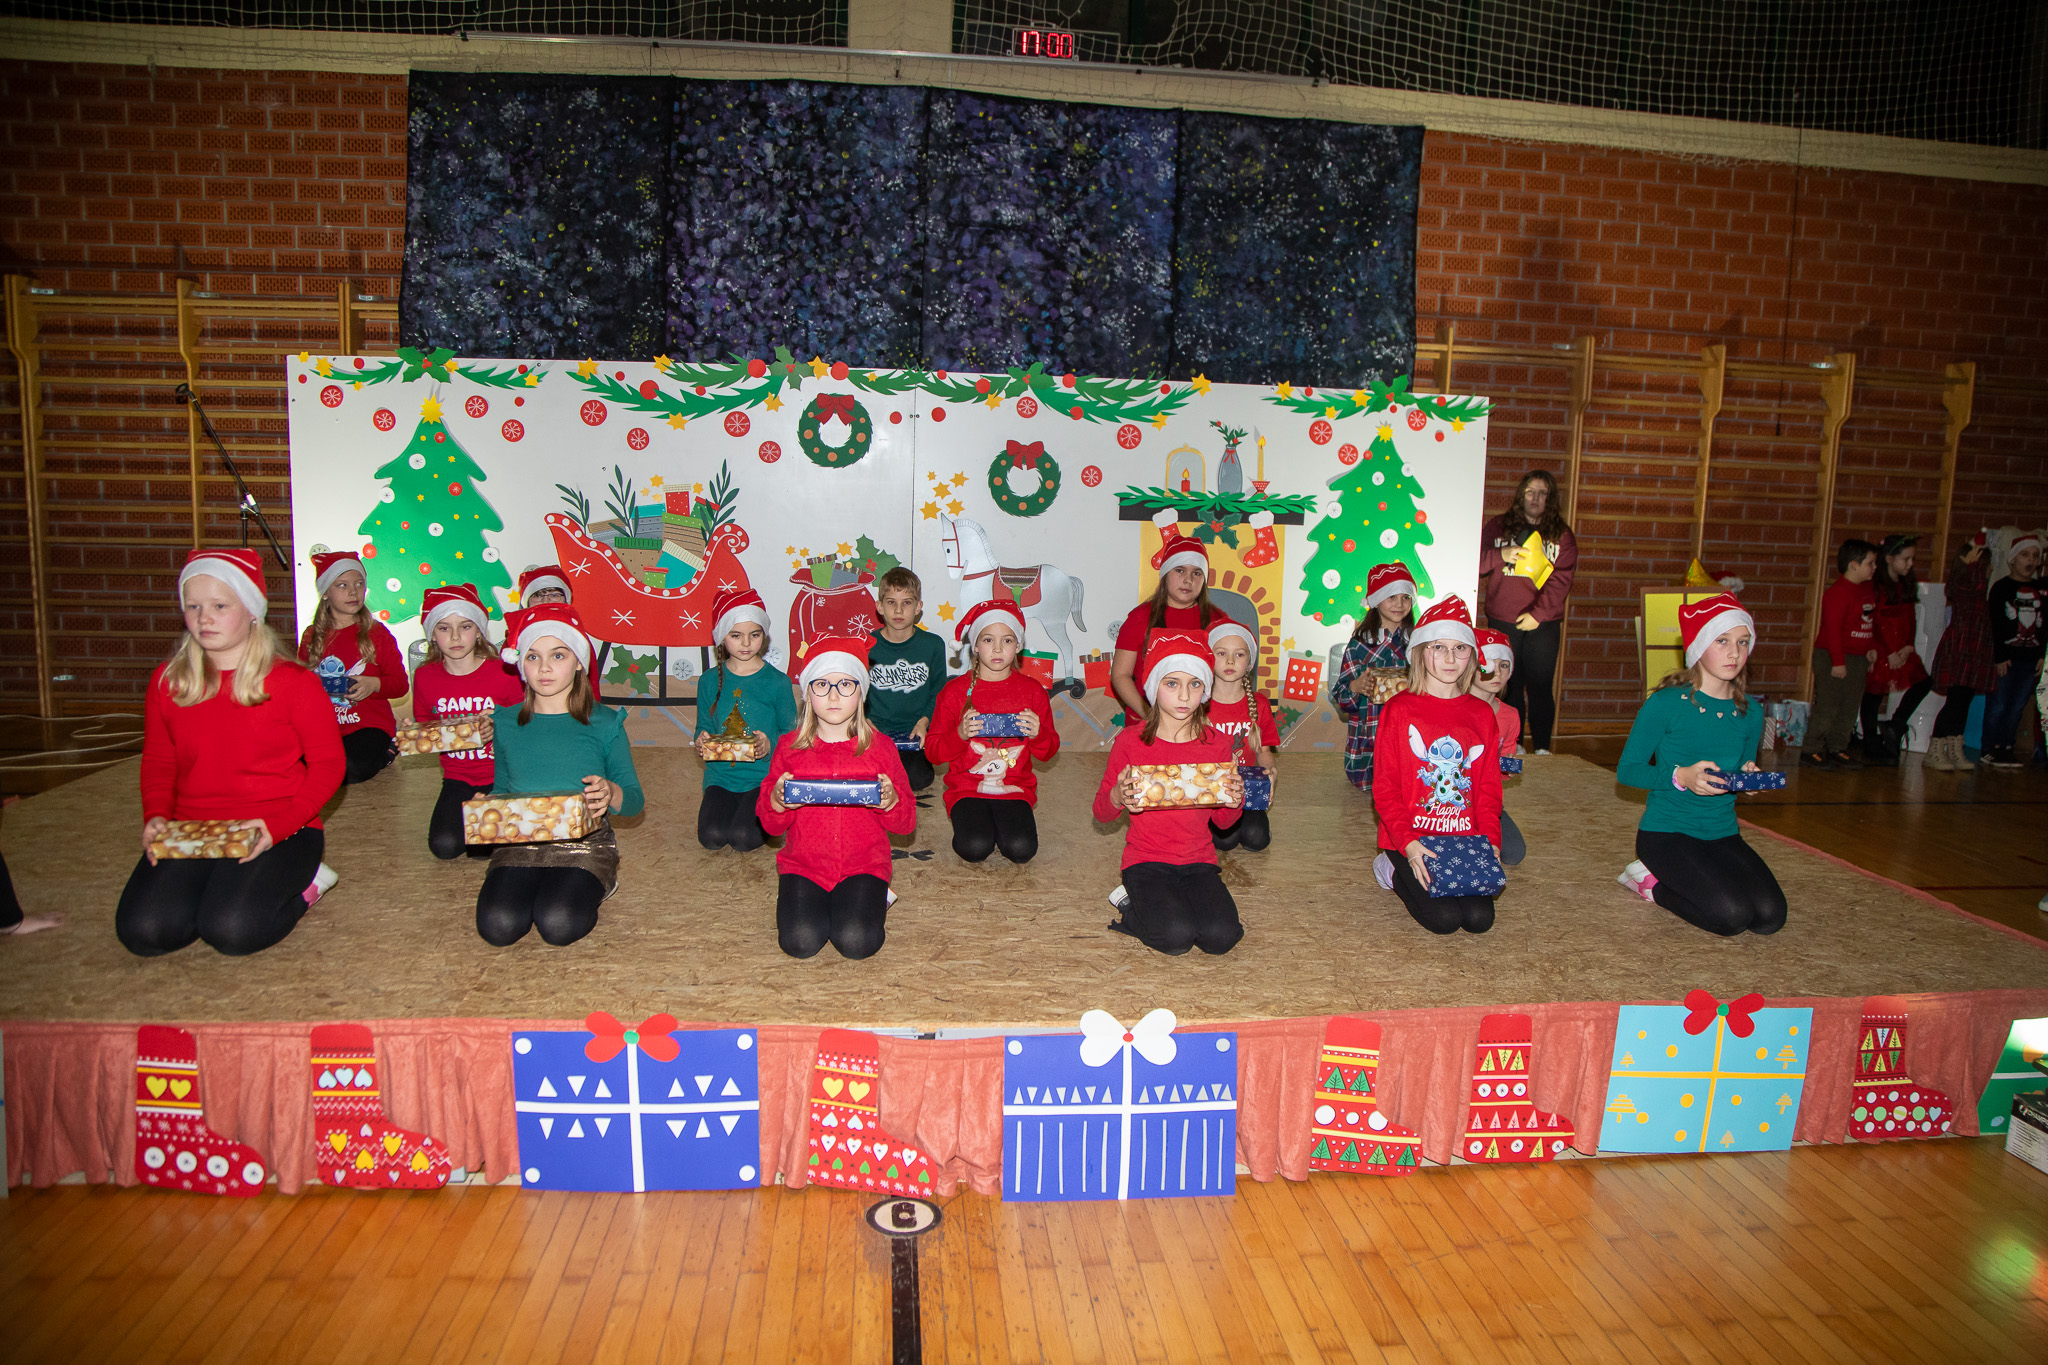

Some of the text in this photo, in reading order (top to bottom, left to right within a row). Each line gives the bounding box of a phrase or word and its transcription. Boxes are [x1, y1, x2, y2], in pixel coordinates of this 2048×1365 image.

[1022, 30, 1072, 58] 17:00
[1427, 801, 1462, 820] Happy
[1412, 815, 1472, 832] STITCHMAS
